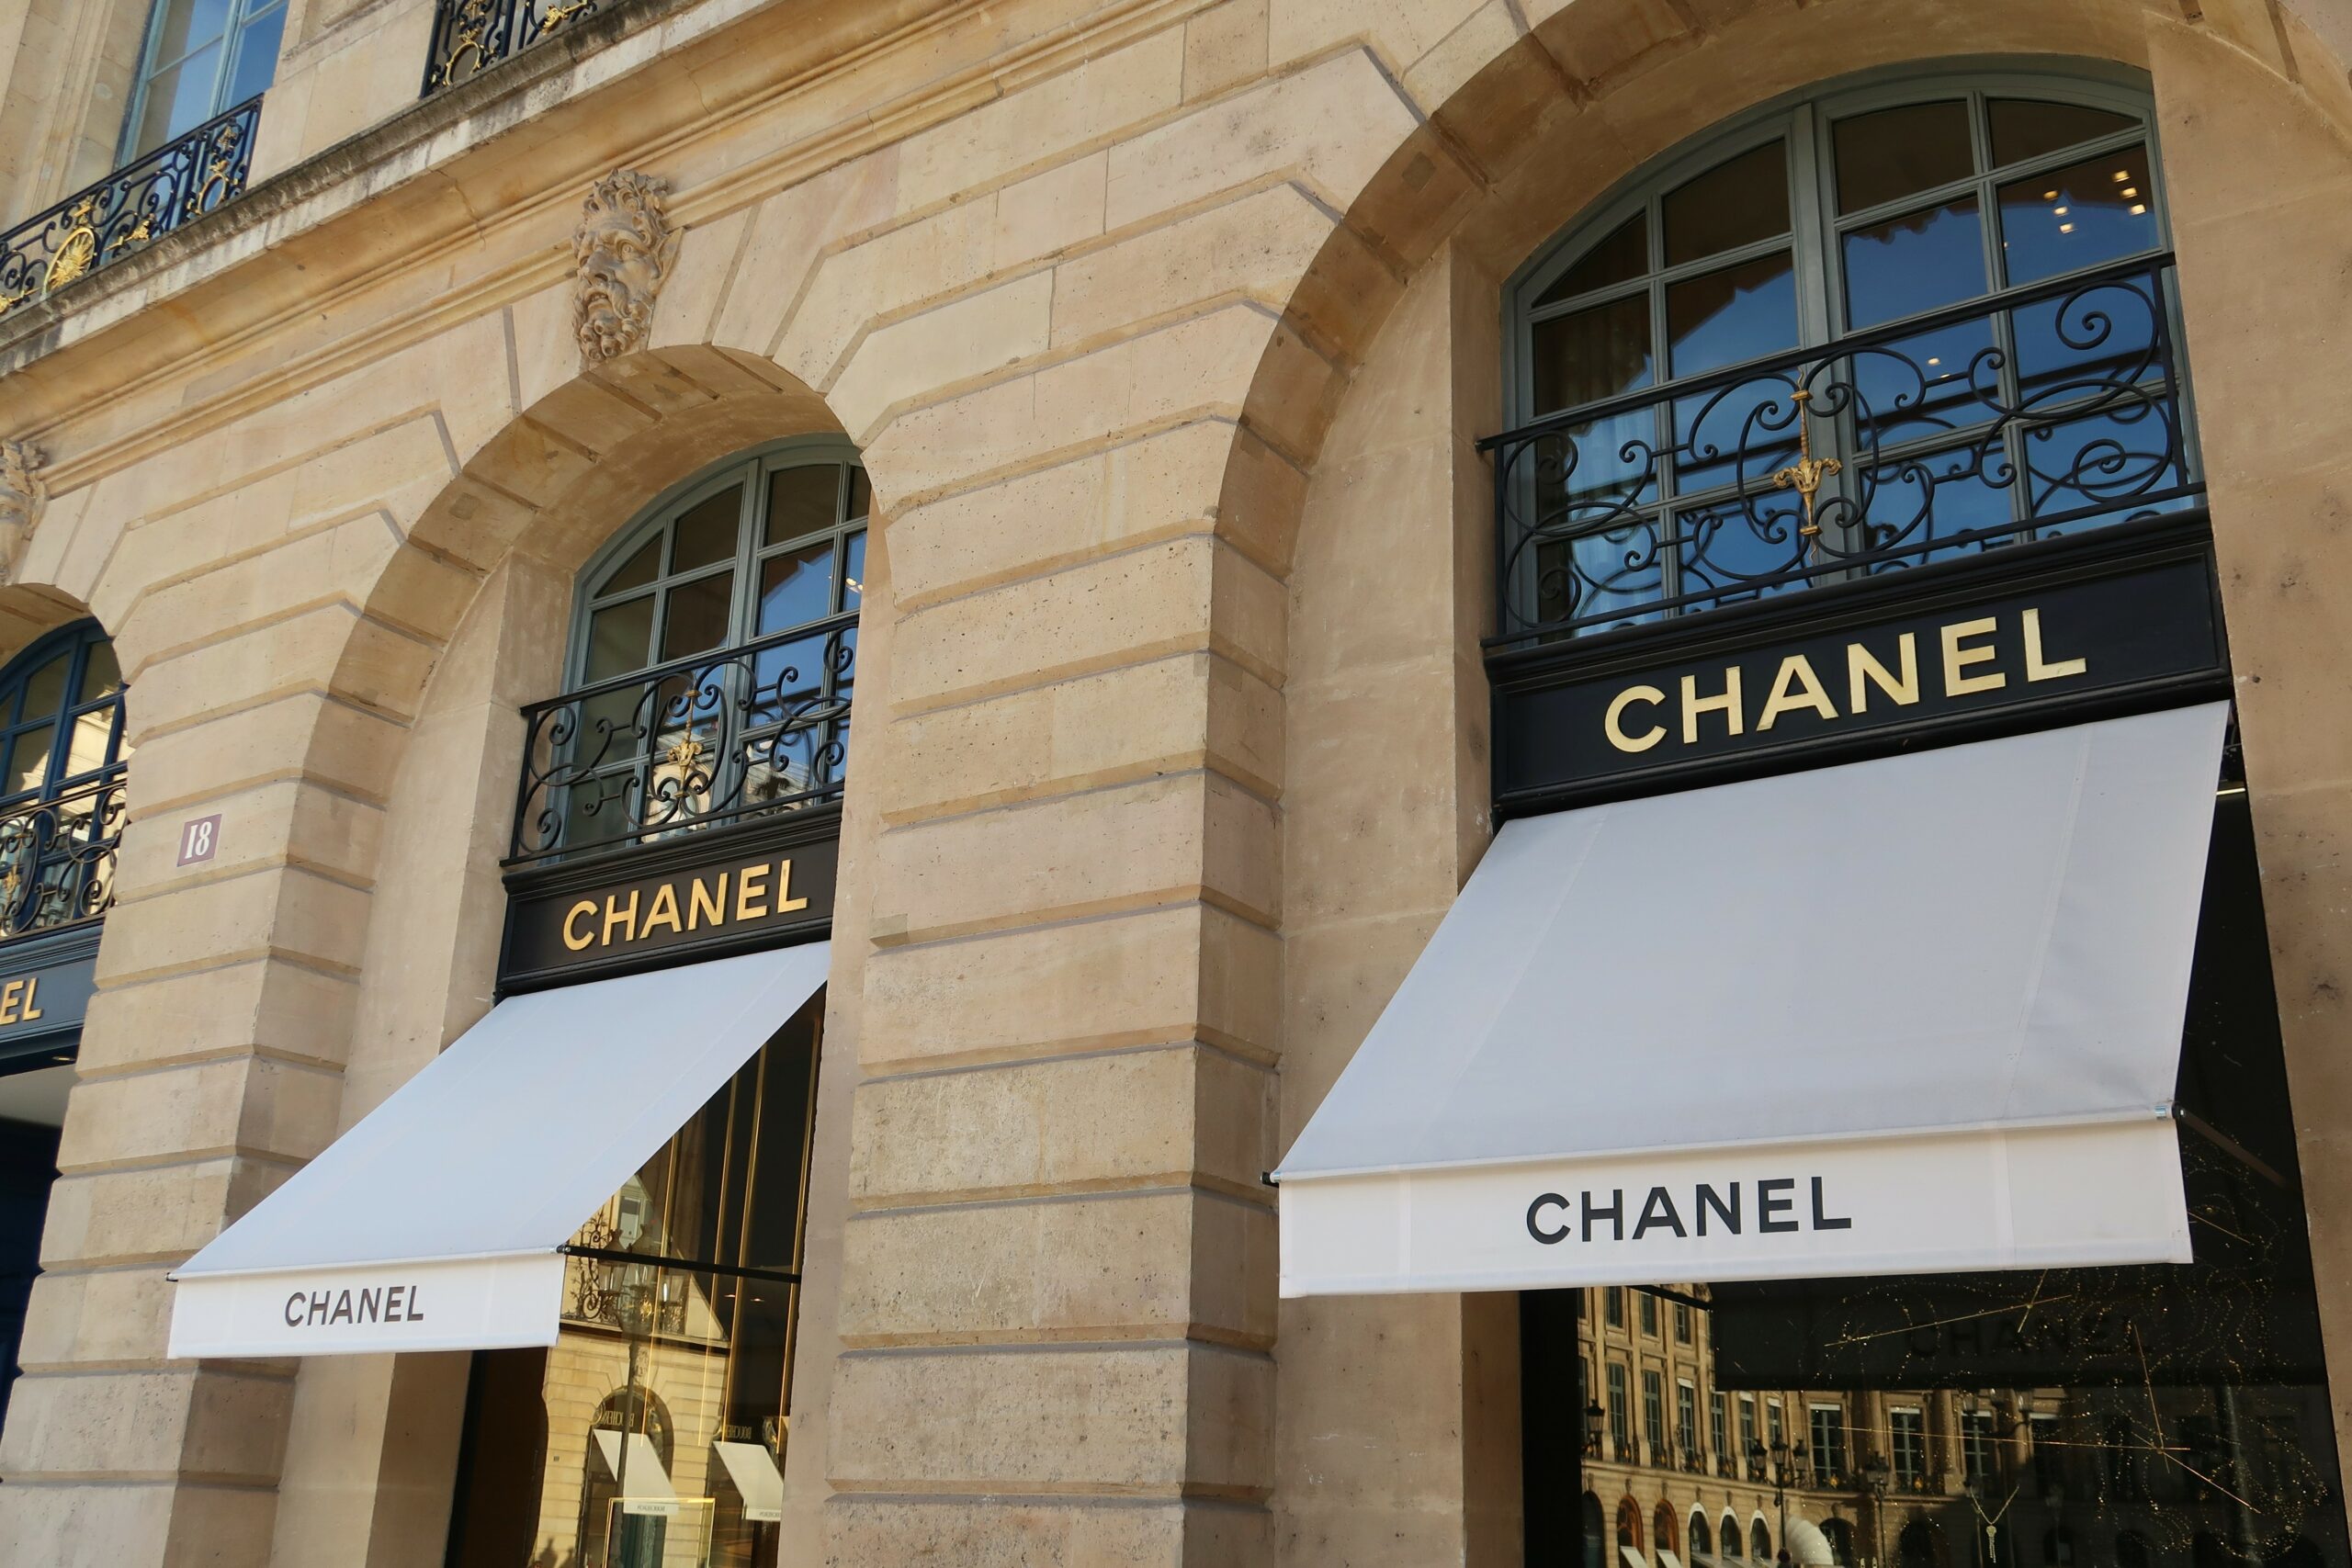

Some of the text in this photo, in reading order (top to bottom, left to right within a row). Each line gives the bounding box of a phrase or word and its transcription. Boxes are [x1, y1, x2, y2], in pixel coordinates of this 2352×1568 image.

[1604, 608, 2087, 753] CHANEL
[185, 821, 212, 860] 18
[562, 859, 808, 952] CHANEL
[0, 977, 42, 1025] EL
[1526, 1176, 1852, 1246] CHANEL
[284, 1285, 424, 1327] CHANEL
